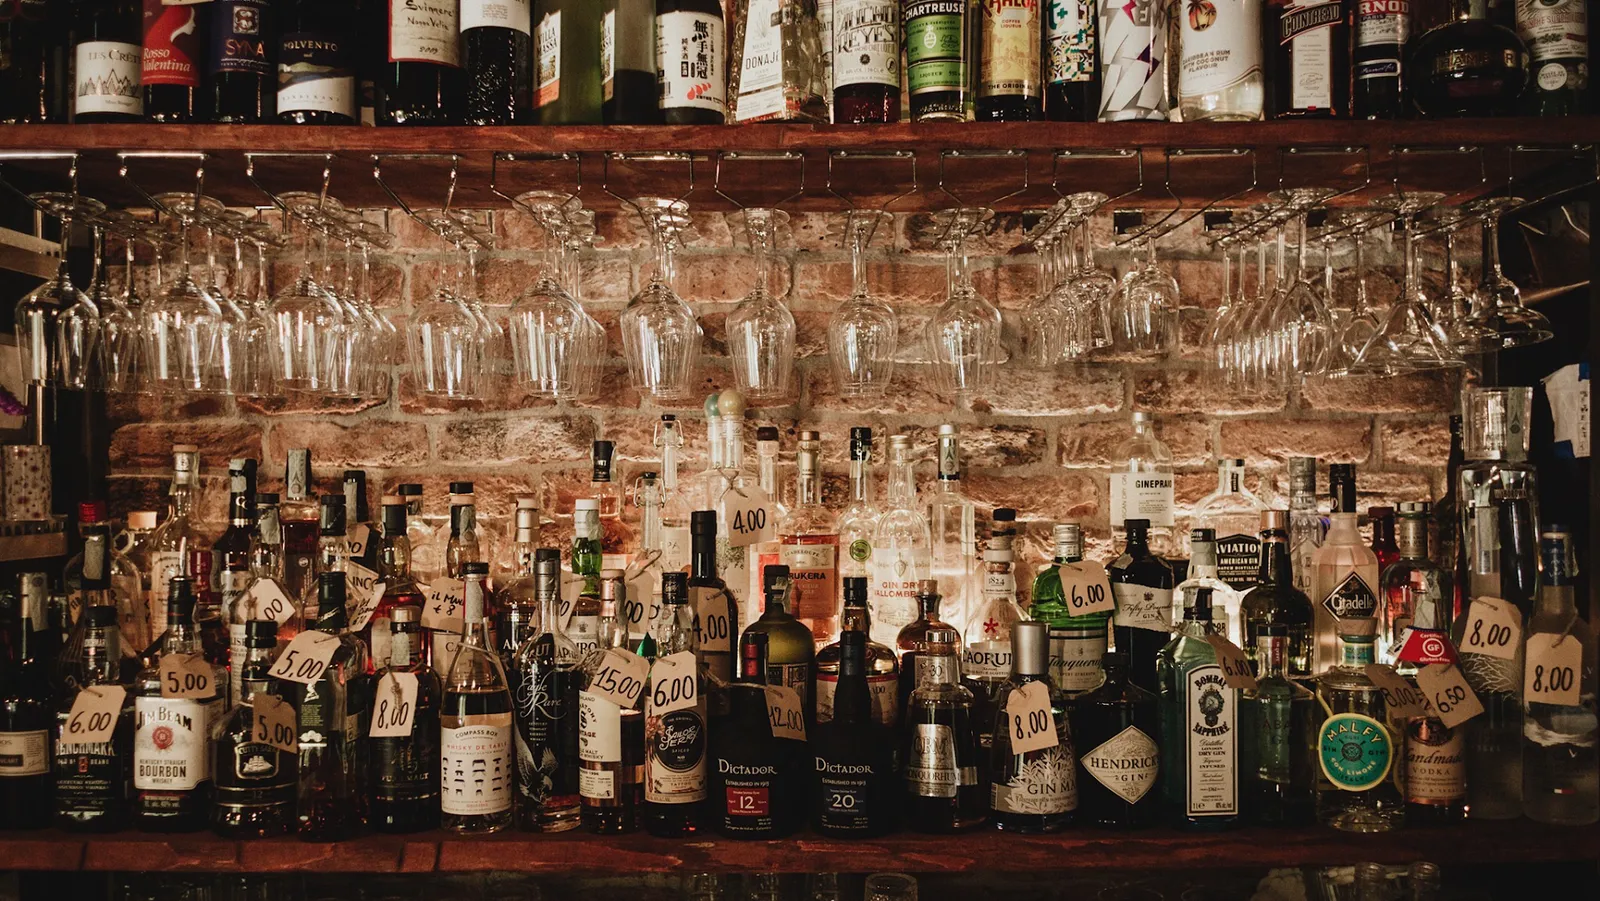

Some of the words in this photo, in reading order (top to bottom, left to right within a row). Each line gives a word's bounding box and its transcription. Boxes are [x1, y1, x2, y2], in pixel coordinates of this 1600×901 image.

[906, 2, 965, 20] CHARTREUSE
[1283, 4, 1341, 38] COINTREAU
[143, 48, 170, 59] Rosso
[1196, 56, 1229, 65] COCONUT
[143, 59, 191, 72] Valentina
[1427, 643, 1441, 651] GF
[277, 650, 324, 679] 5,00
[593, 666, 642, 700] 15,00
[653, 675, 695, 707] 6,00
[158, 706, 192, 731] BEAM
[1014, 709, 1048, 740] 8,00
[455, 729, 485, 739] COMPASS
[486, 729, 499, 737] BOX
[1193, 721, 1231, 737] SAPPHIRE
[1327, 722, 1382, 743] MALFY
[140, 765, 187, 778] BOURBON
[1121, 773, 1144, 781] GIN
[1412, 767, 1451, 775] VODKA
[1027, 783, 1056, 795] GIN
[740, 795, 755, 810] 12
[832, 793, 855, 809] 20
